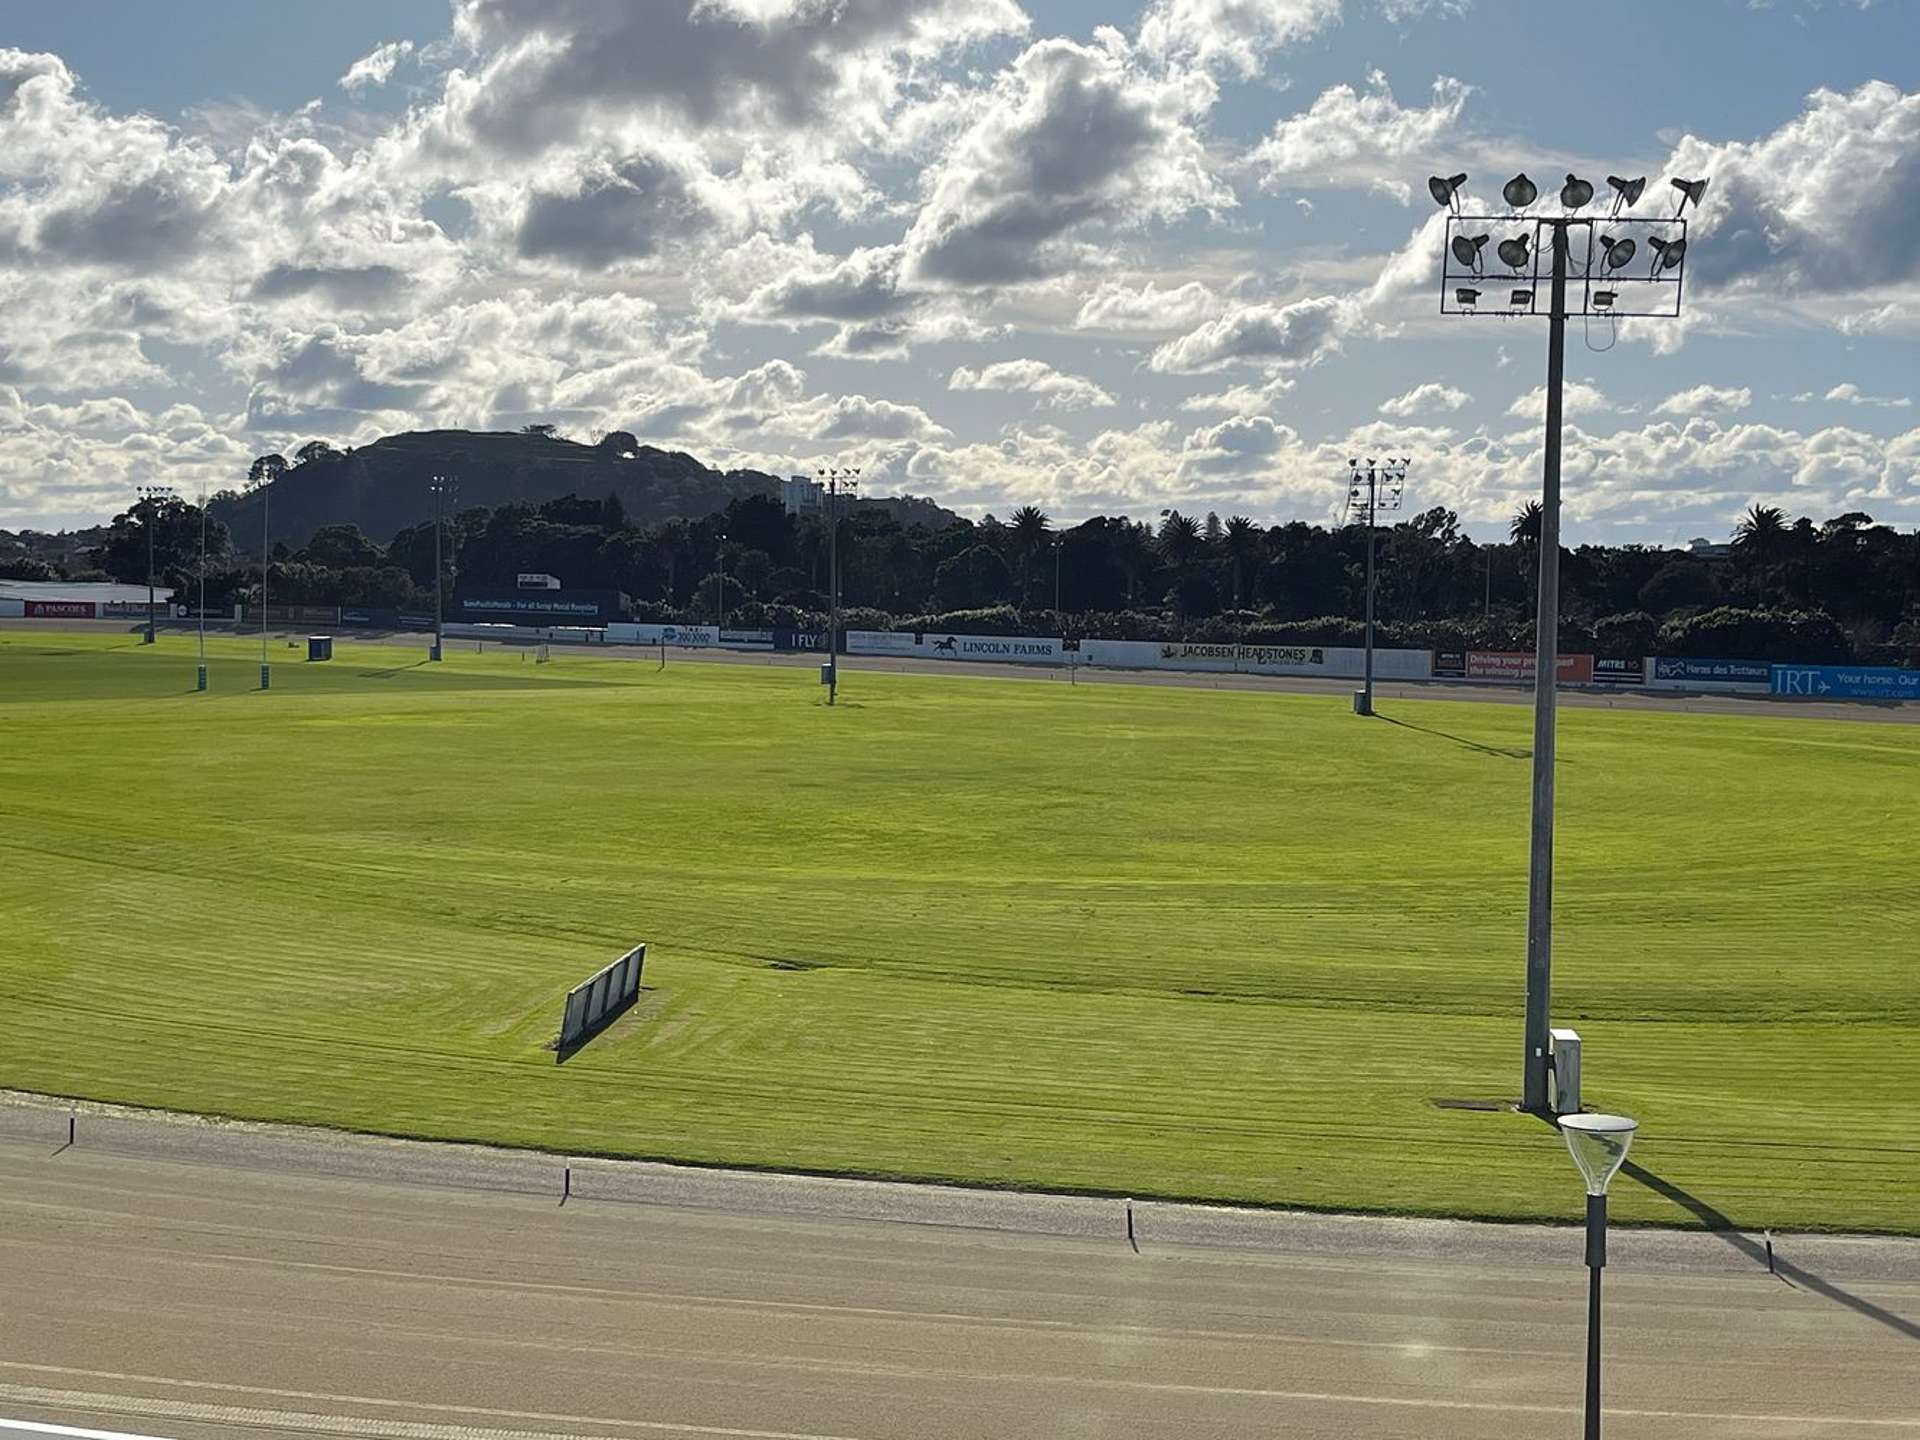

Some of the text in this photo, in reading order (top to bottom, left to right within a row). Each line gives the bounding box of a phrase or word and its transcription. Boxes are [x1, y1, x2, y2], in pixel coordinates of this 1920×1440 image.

[799, 634, 818, 648] FLY
[963, 642, 1052, 656] LINCOLN FARMS
[1180, 646, 1306, 661] JACOBSEN HEADSTONES
[1470, 654, 1501, 668] Driving
[1502, 657, 1522, 668] your
[1597, 659, 1625, 669] MITRE
[1776, 670, 1821, 695] IRT
[1837, 673, 1861, 684] Your
[1898, 675, 1919, 686] Our
